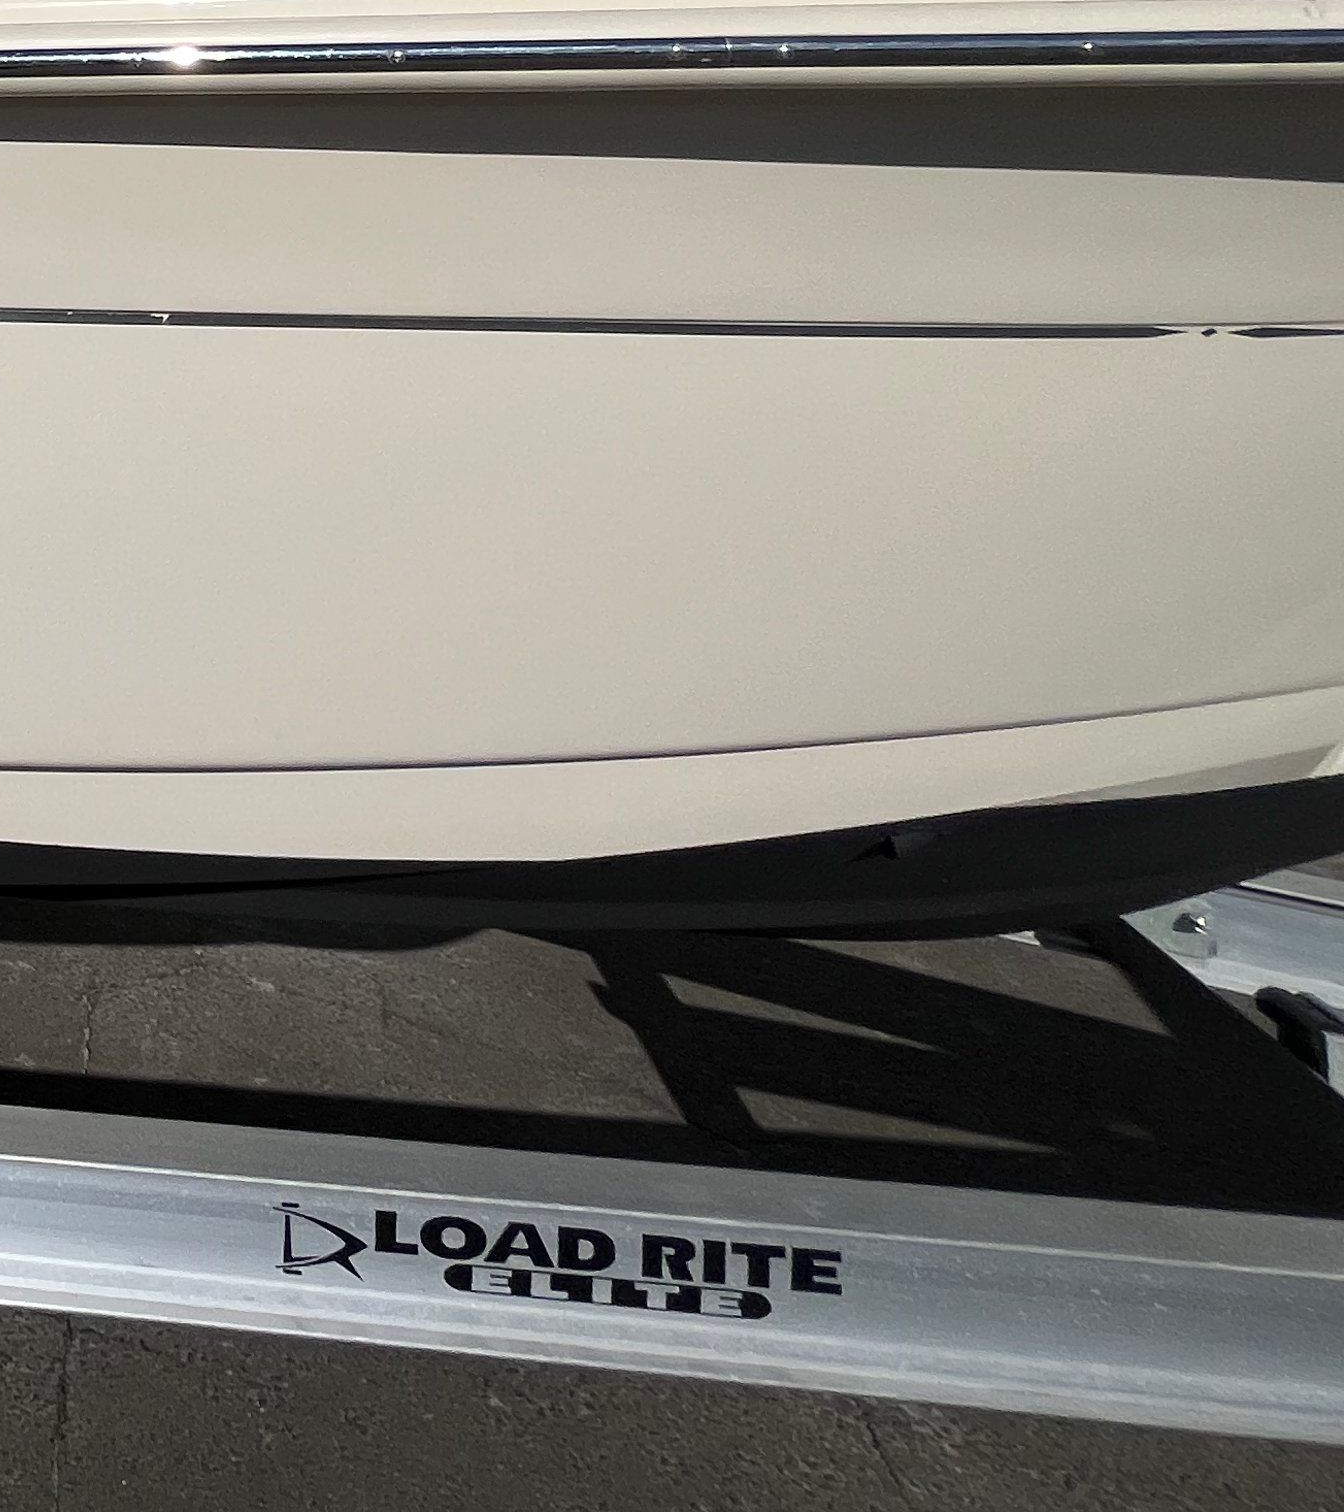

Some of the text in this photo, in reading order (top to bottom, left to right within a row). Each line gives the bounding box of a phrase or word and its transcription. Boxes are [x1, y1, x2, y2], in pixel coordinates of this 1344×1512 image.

[374, 1210, 844, 1295] LOAD RITE
[470, 1265, 744, 1318] ELITE
